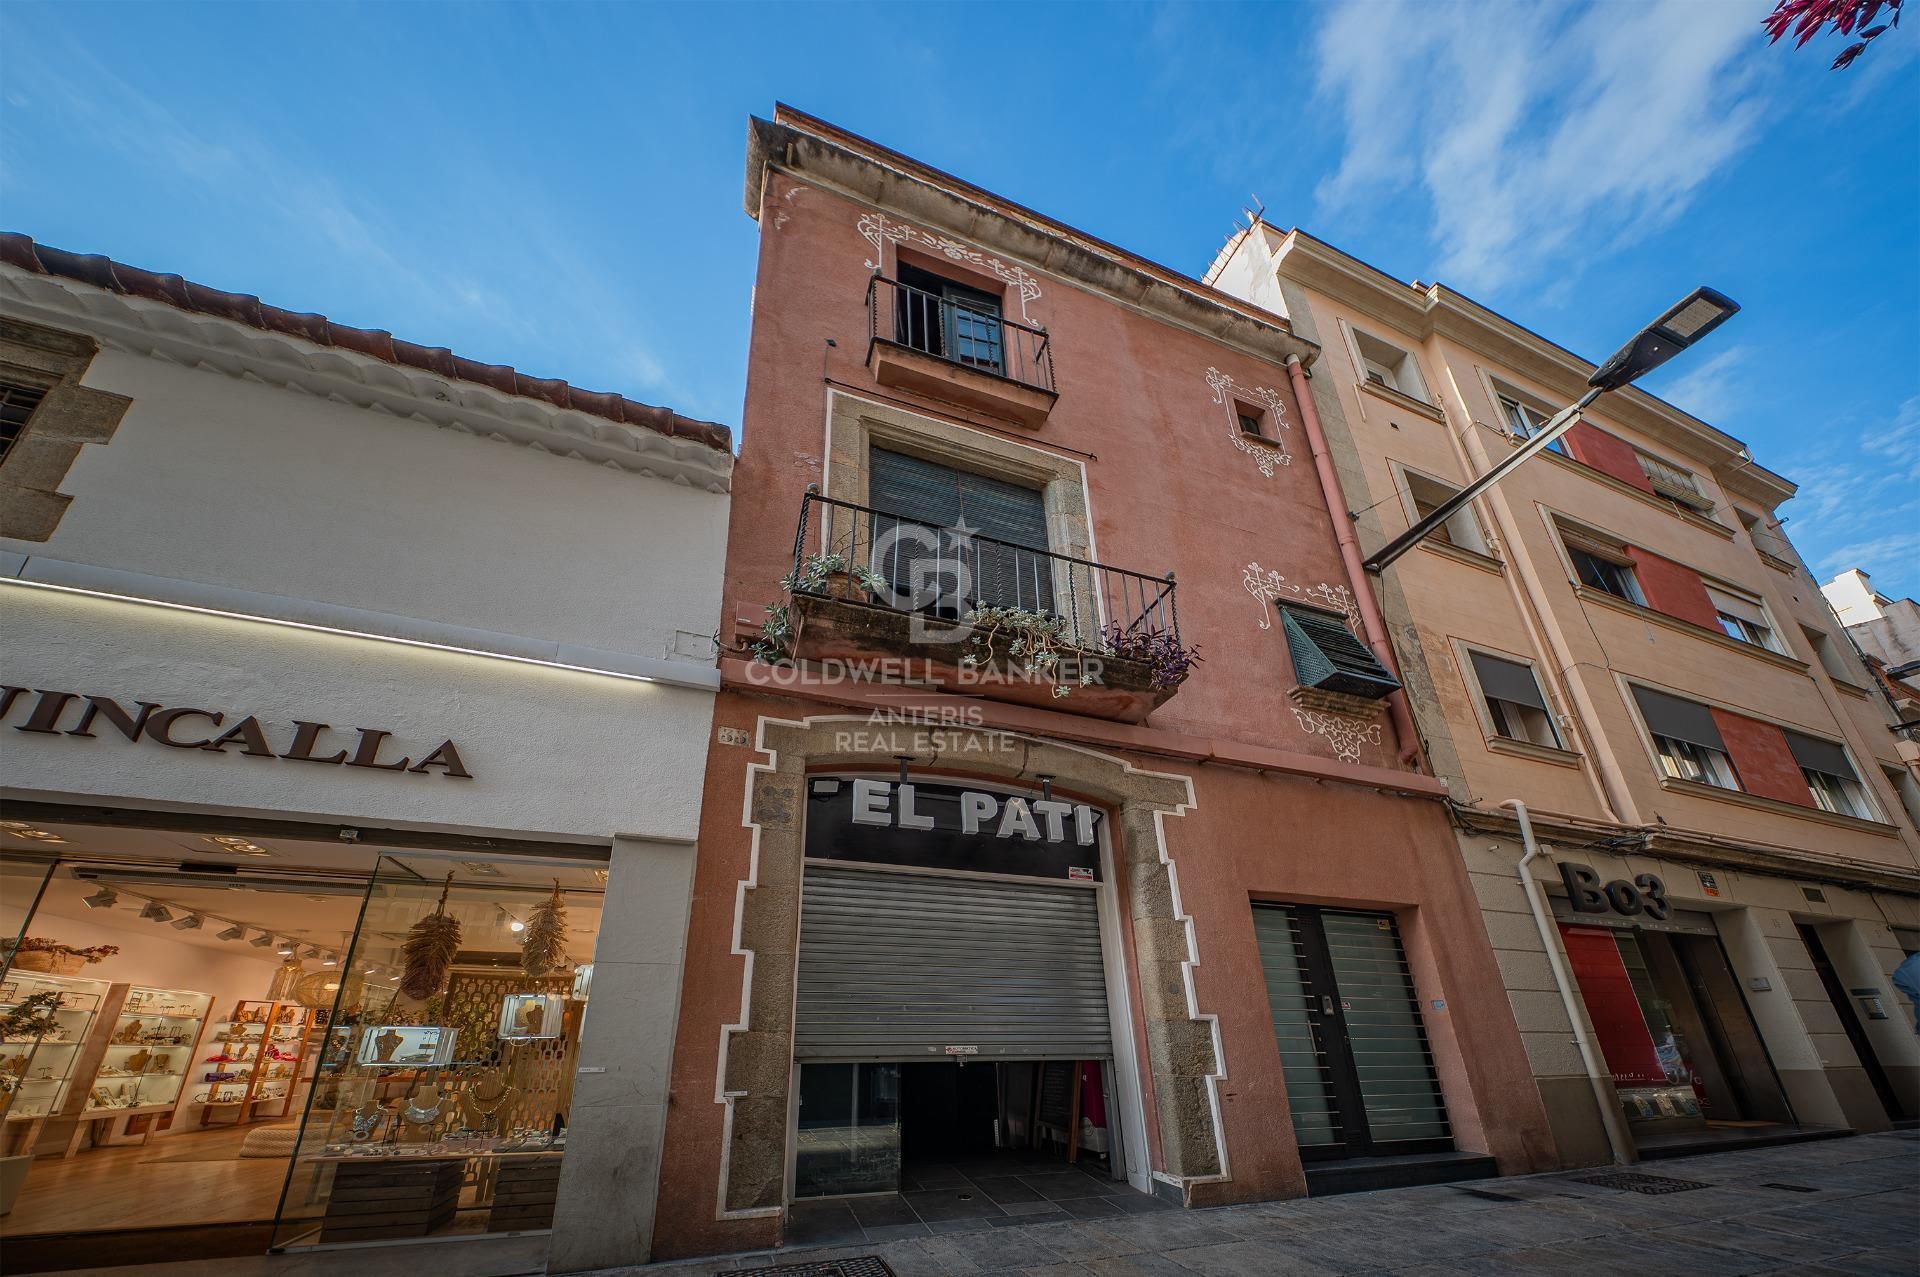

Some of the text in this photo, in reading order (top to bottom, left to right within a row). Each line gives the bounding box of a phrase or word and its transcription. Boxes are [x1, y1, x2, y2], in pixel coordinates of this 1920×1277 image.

[852, 779, 1094, 846] EL PATI
[1557, 862, 1674, 920] Bo3
